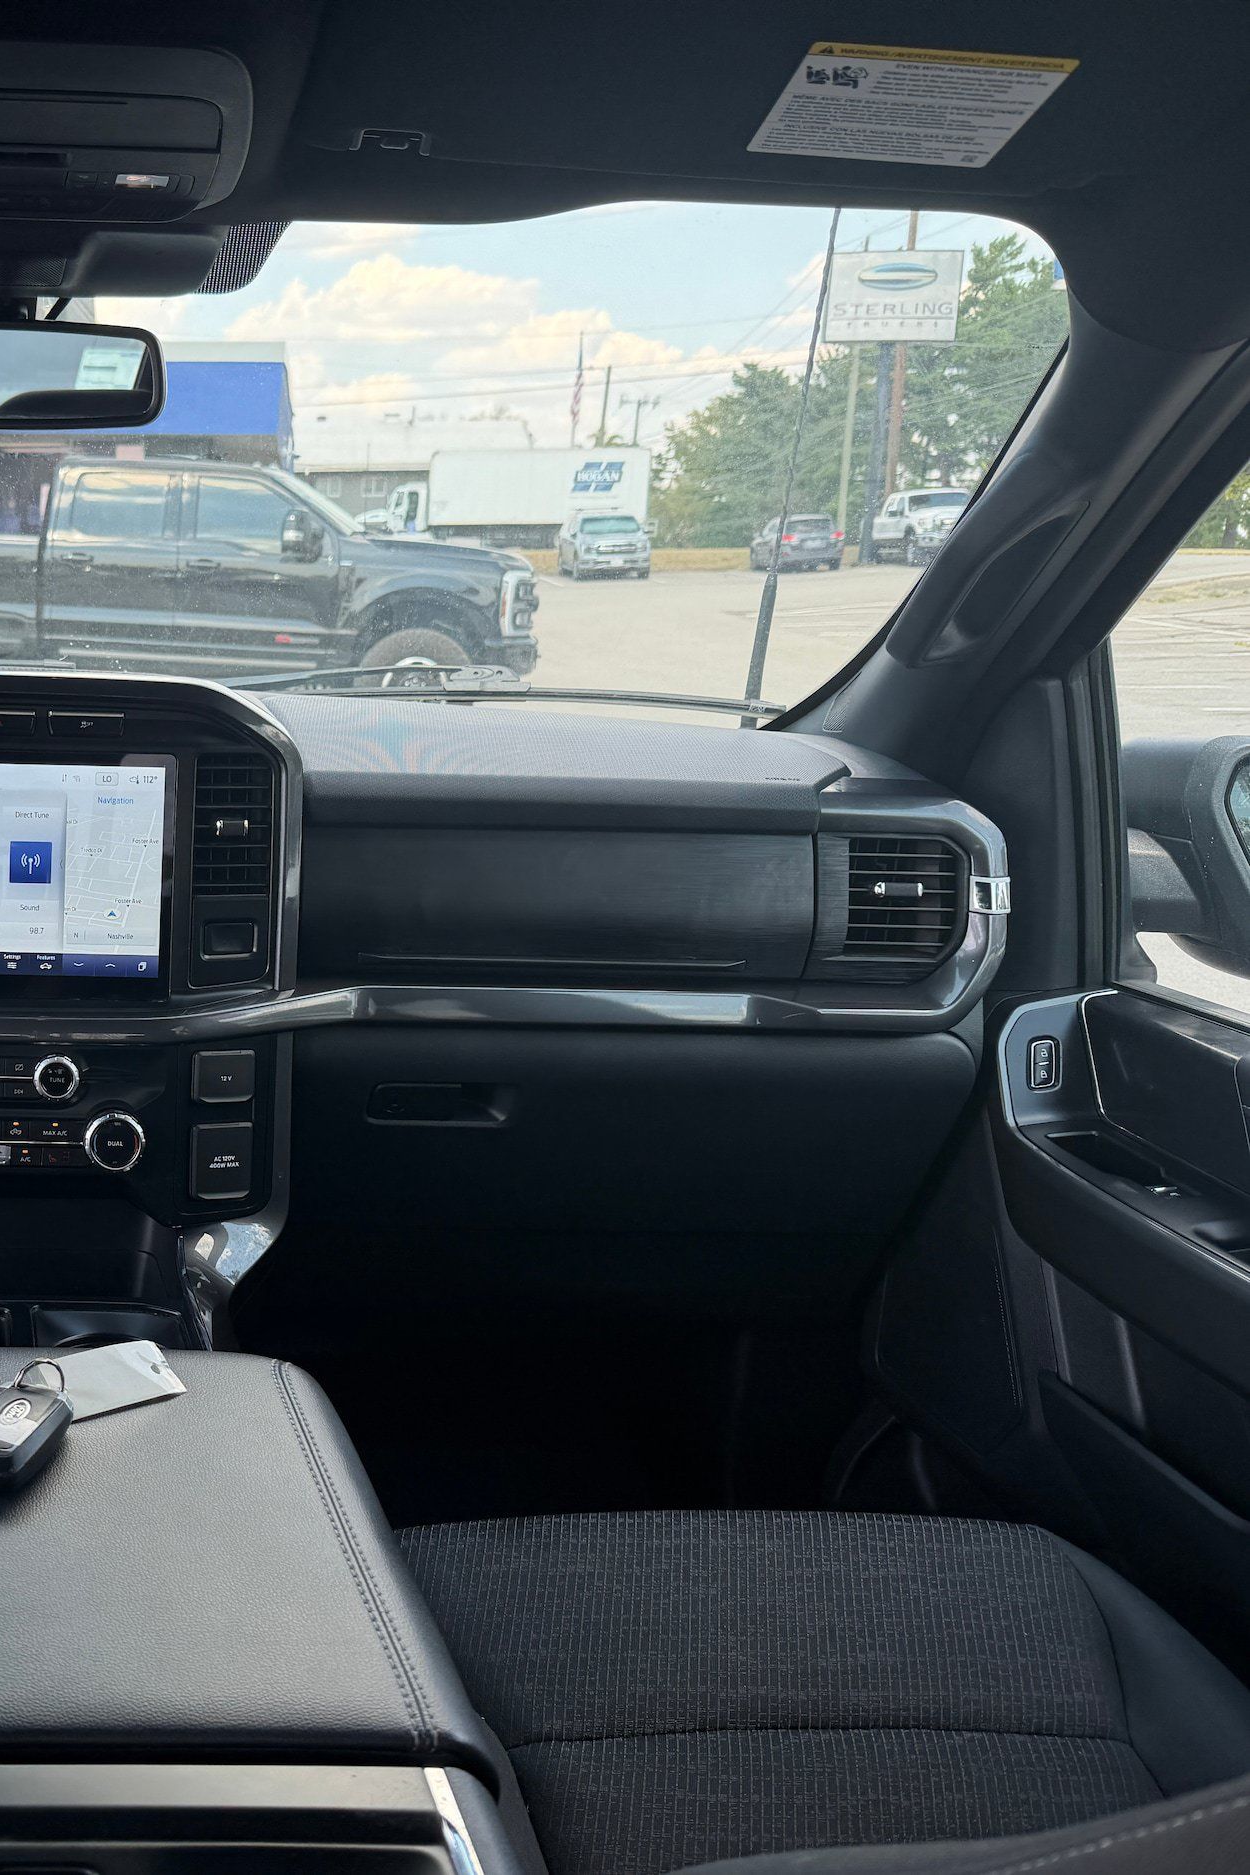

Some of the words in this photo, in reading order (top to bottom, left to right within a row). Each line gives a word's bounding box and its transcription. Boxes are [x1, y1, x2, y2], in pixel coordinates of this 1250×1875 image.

[833, 302, 954, 317] STERLING
[577, 470, 620, 482] HOGAN
[102, 775, 112, 783] LO
[97, 796, 134, 806] Navigation
[15, 811, 33, 820] Direct
[34, 811, 50, 820] Tune
[114, 897, 131, 905] Foster
[29, 926, 44, 935] 98.7
[107, 932, 134, 940] Nashville
[3, 953, 22, 961] Settings
